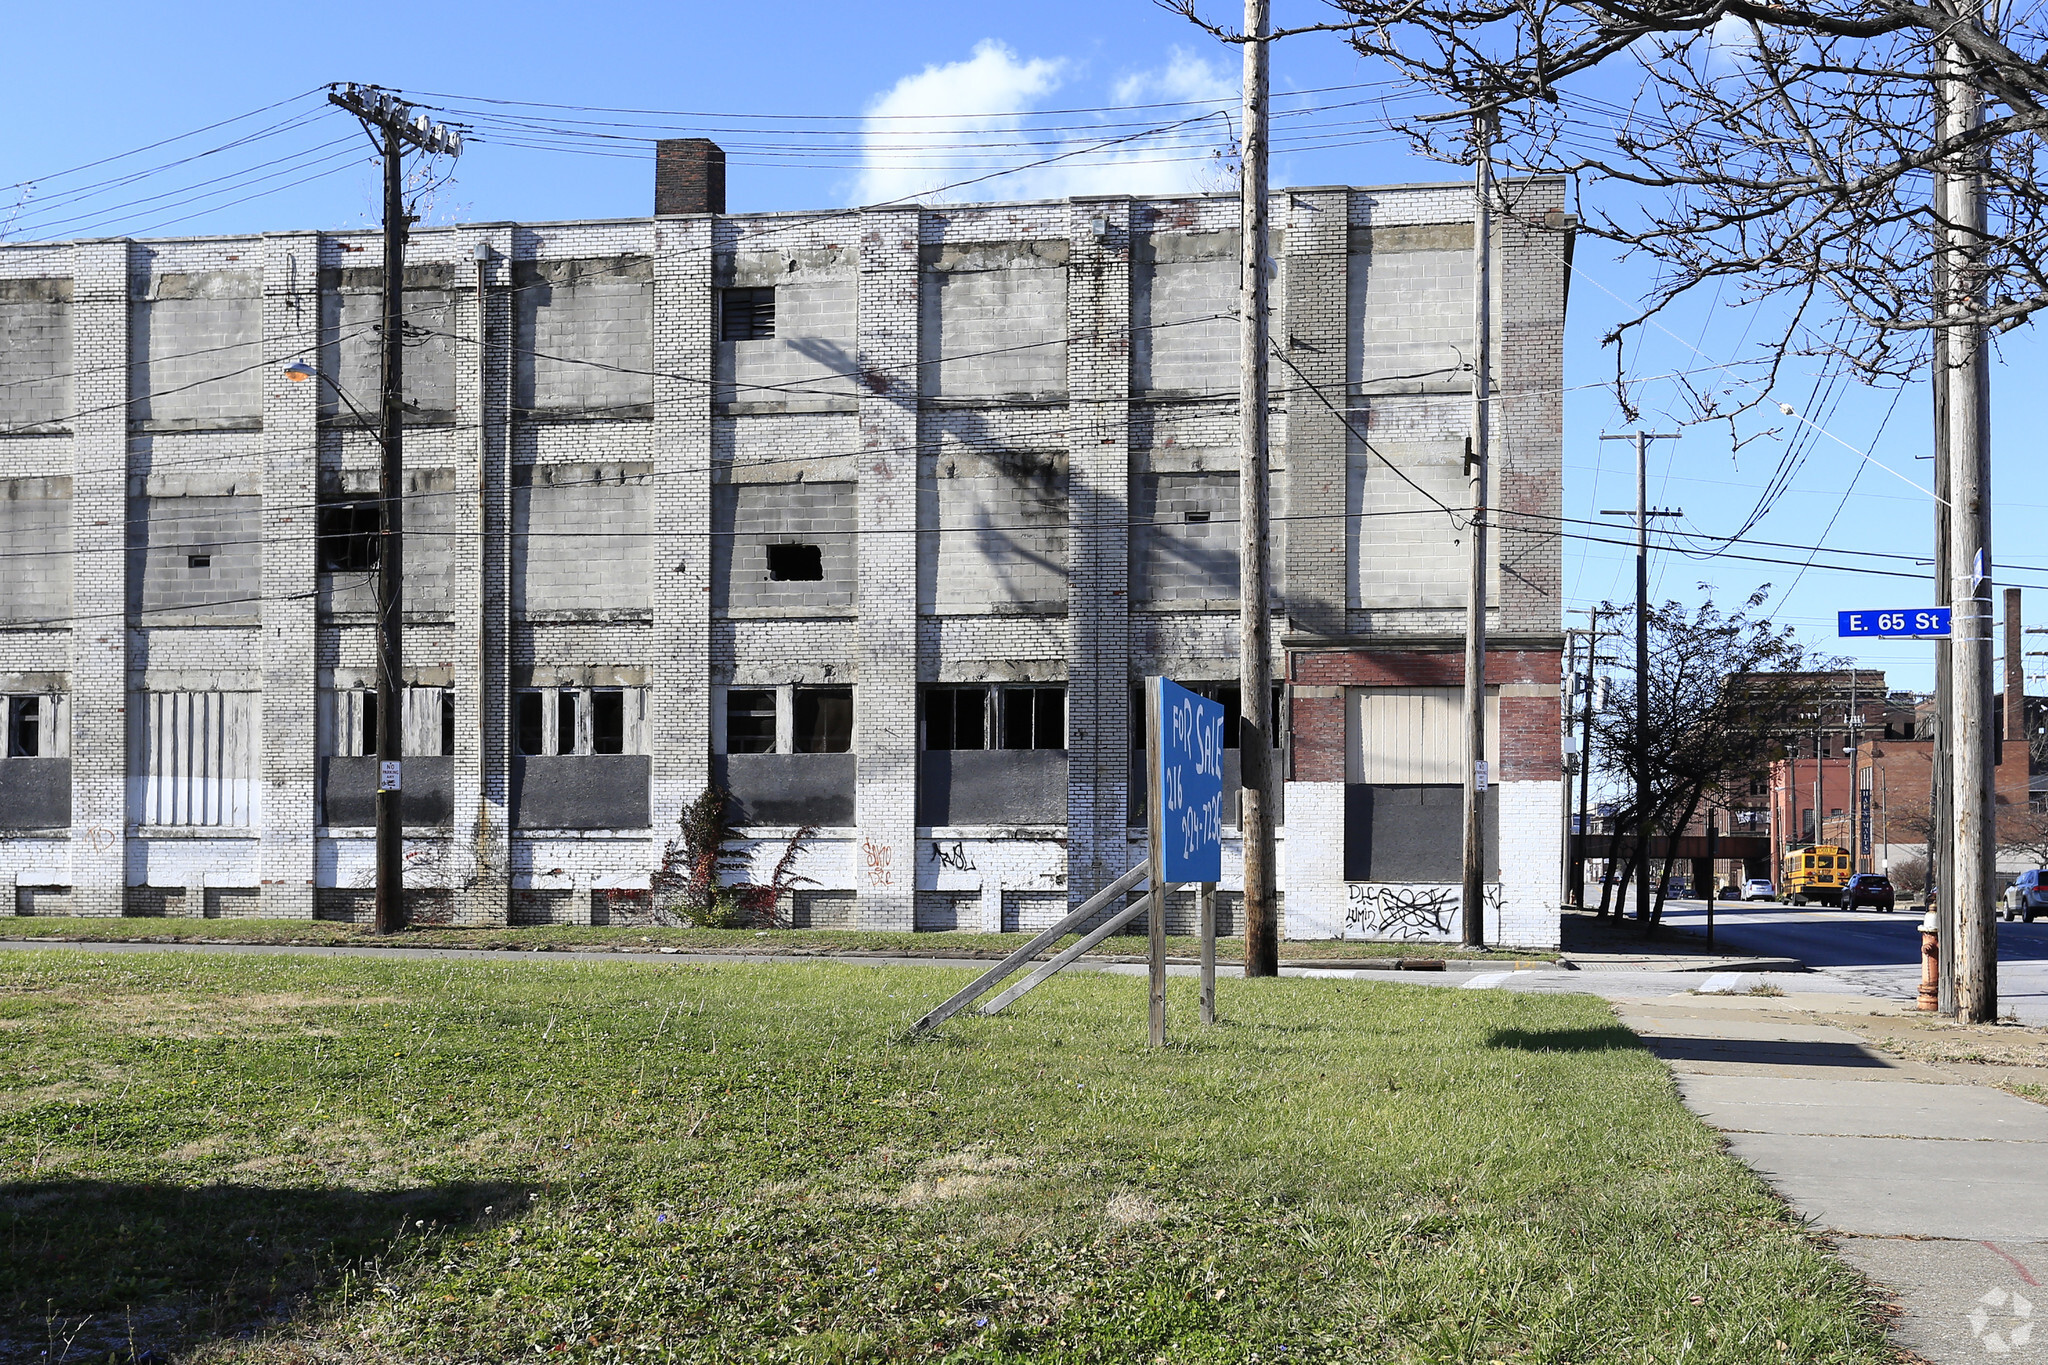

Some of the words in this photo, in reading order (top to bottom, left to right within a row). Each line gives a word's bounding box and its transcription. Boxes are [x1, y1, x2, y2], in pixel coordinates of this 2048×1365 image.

[1850, 614, 1869, 631] E.
[1878, 613, 1905, 631] 65
[1915, 612, 1940, 630] St
[1173, 697, 1193, 760] FOR
[1166, 765, 1183, 812] 216
